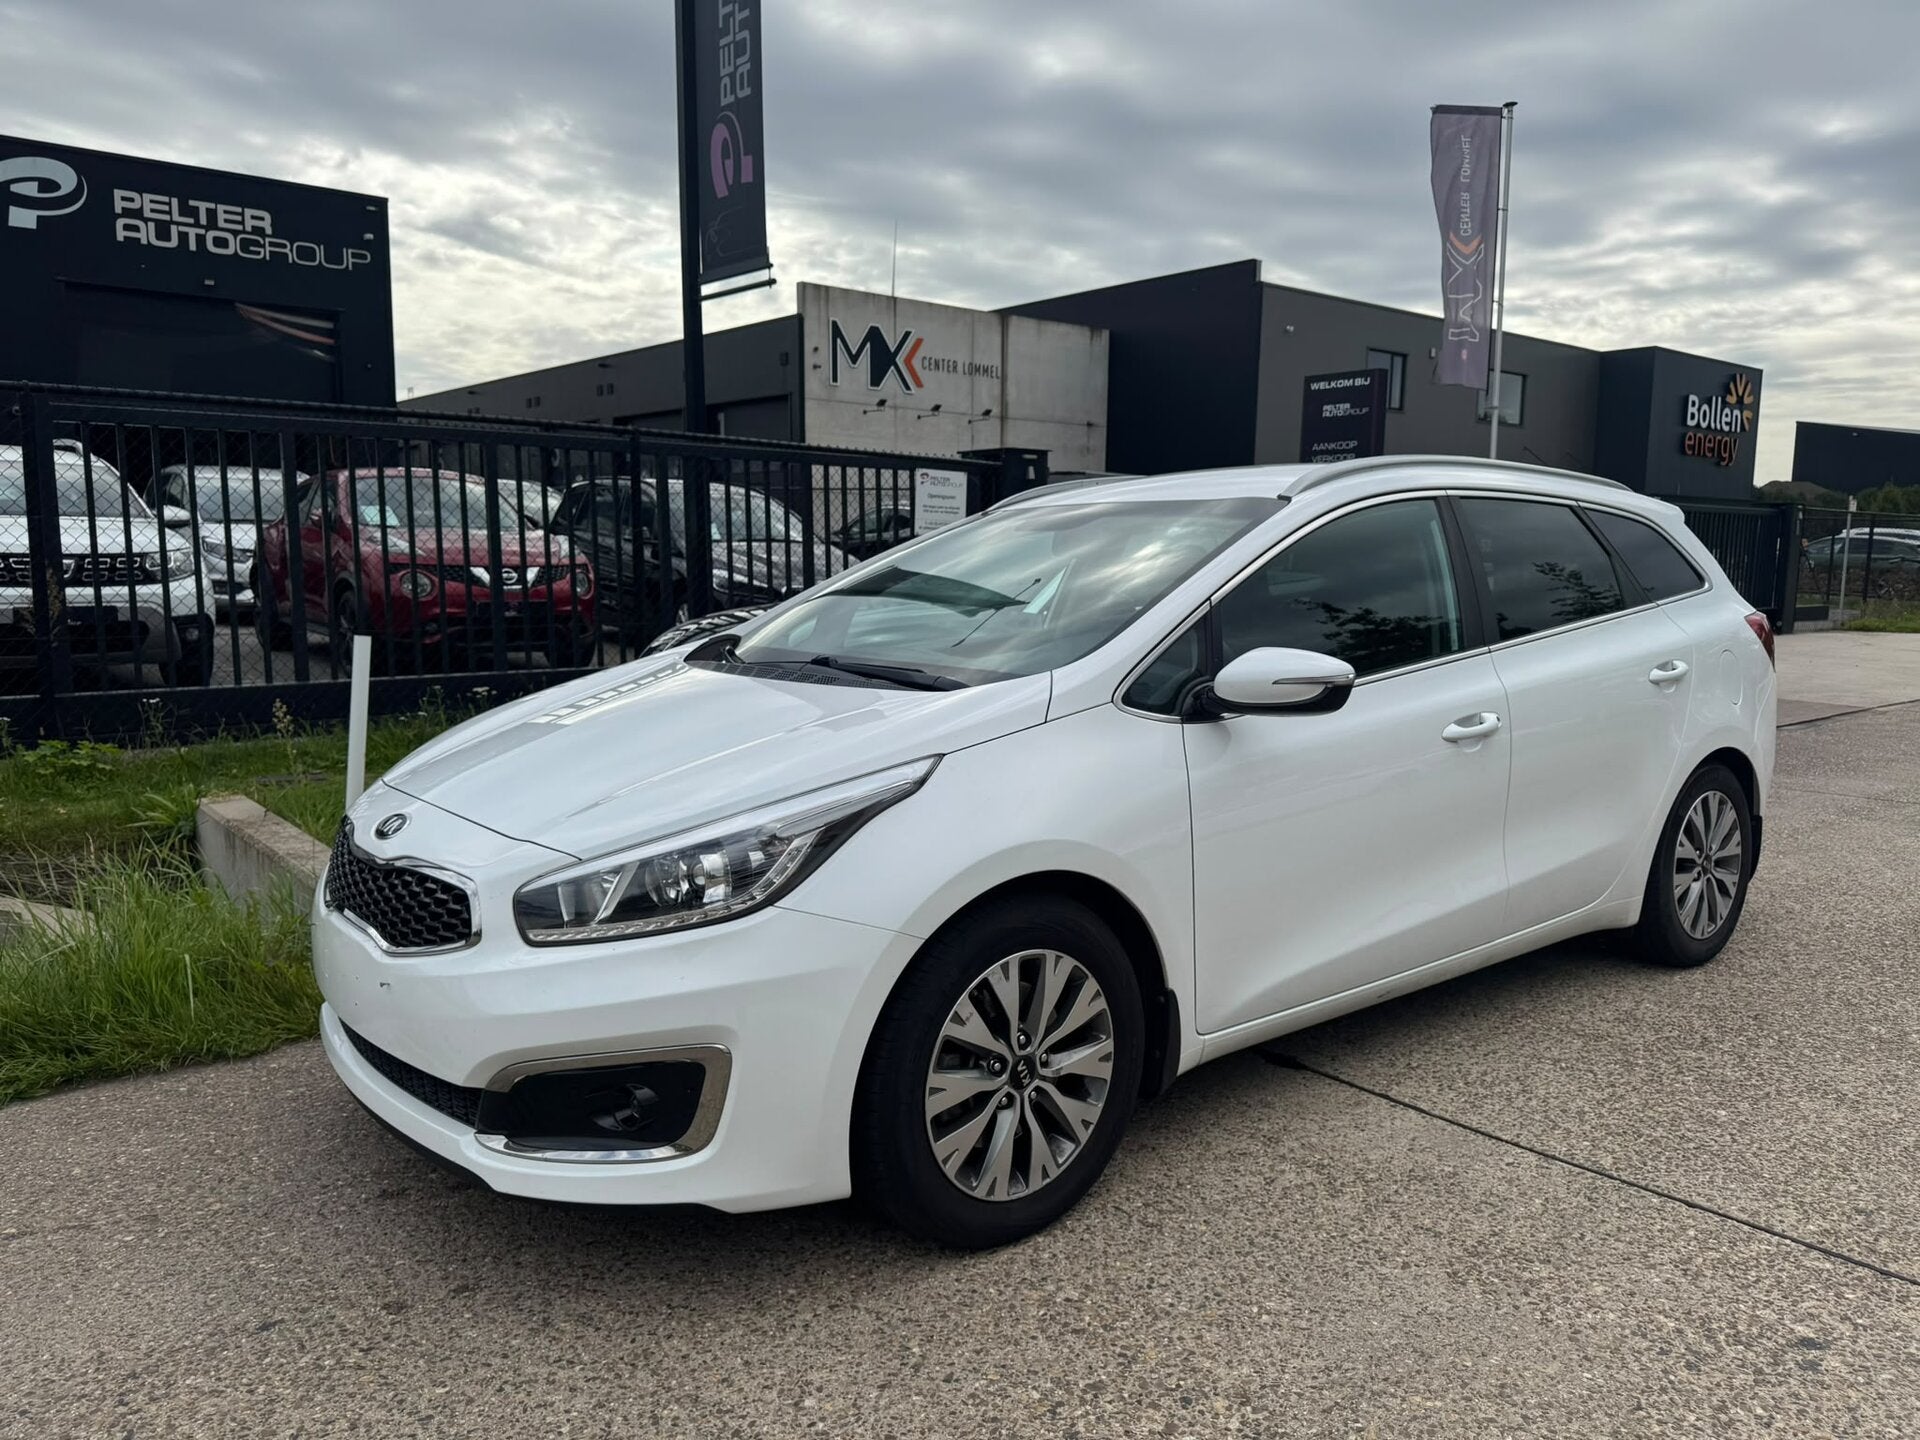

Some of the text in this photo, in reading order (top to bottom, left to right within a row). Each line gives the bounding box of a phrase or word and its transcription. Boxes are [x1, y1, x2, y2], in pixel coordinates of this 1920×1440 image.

[113, 188, 273, 235] PELTER
[115, 217, 371, 270] AUTOGROUP
[921, 356, 958, 374] CENTER
[963, 361, 1000, 379] LOMMEL
[1310, 377, 1371, 391] WELKOM BIJ
[1322, 402, 1351, 411] PELTER
[1686, 394, 1741, 433] Bollen
[1312, 440, 1358, 450] AANKOOP
[1684, 431, 1739, 466] energy
[1016, 1059, 1031, 1087] KIA
